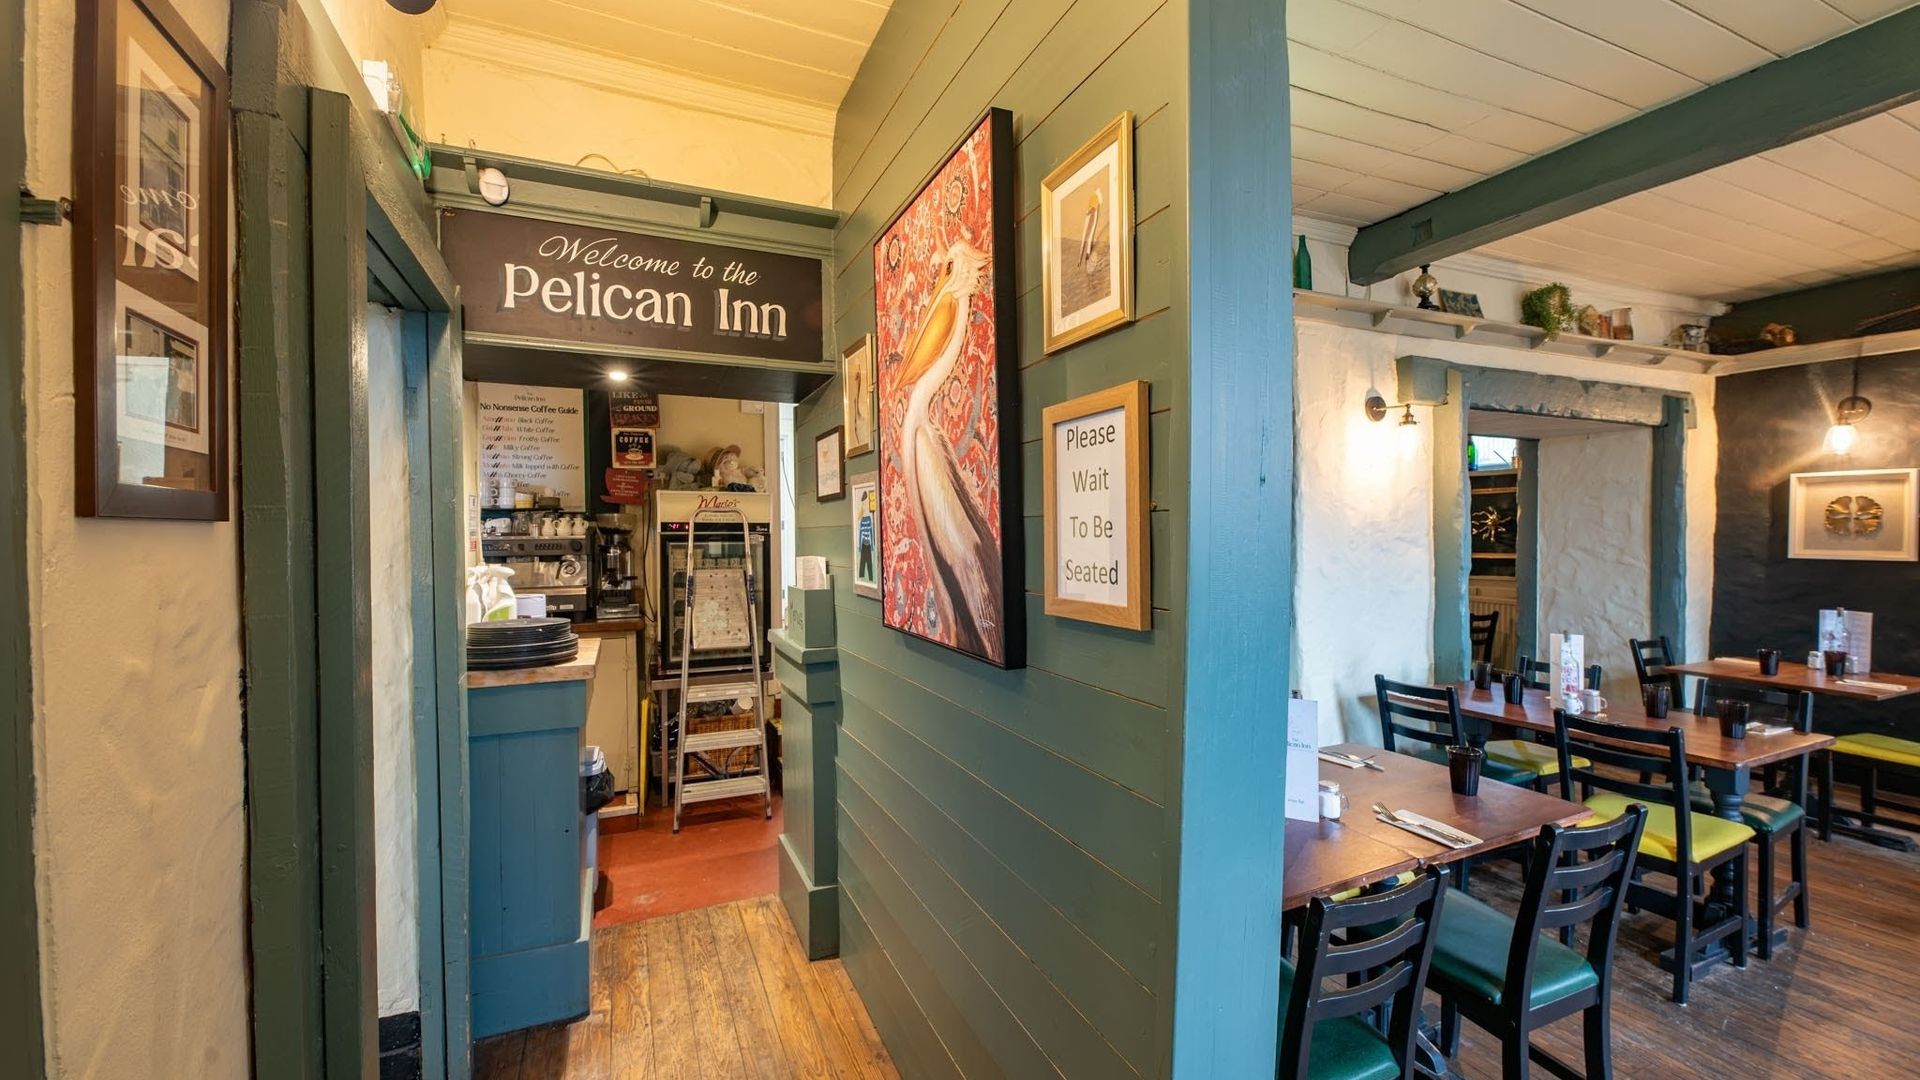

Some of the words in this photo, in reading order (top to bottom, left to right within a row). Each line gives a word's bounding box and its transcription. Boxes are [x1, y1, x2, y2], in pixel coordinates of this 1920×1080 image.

[538, 235, 680, 276] Welcome
[692, 256, 714, 280] to
[722, 261, 760, 286] the
[503, 262, 693, 329] Pelican
[714, 288, 787, 338] Inn
[612, 391, 639, 399] LIKE
[480, 402, 491, 410] No
[492, 403, 529, 412] Nonsense
[530, 405, 556, 414] Coffee
[557, 406, 579, 415] Guide
[619, 436, 649, 444] COFFEE
[1066, 424, 1115, 450] Please
[1072, 467, 1109, 493] Wait
[1070, 516, 1088, 538] To
[1093, 515, 1113, 538] Be
[1066, 559, 1118, 585] Seated
